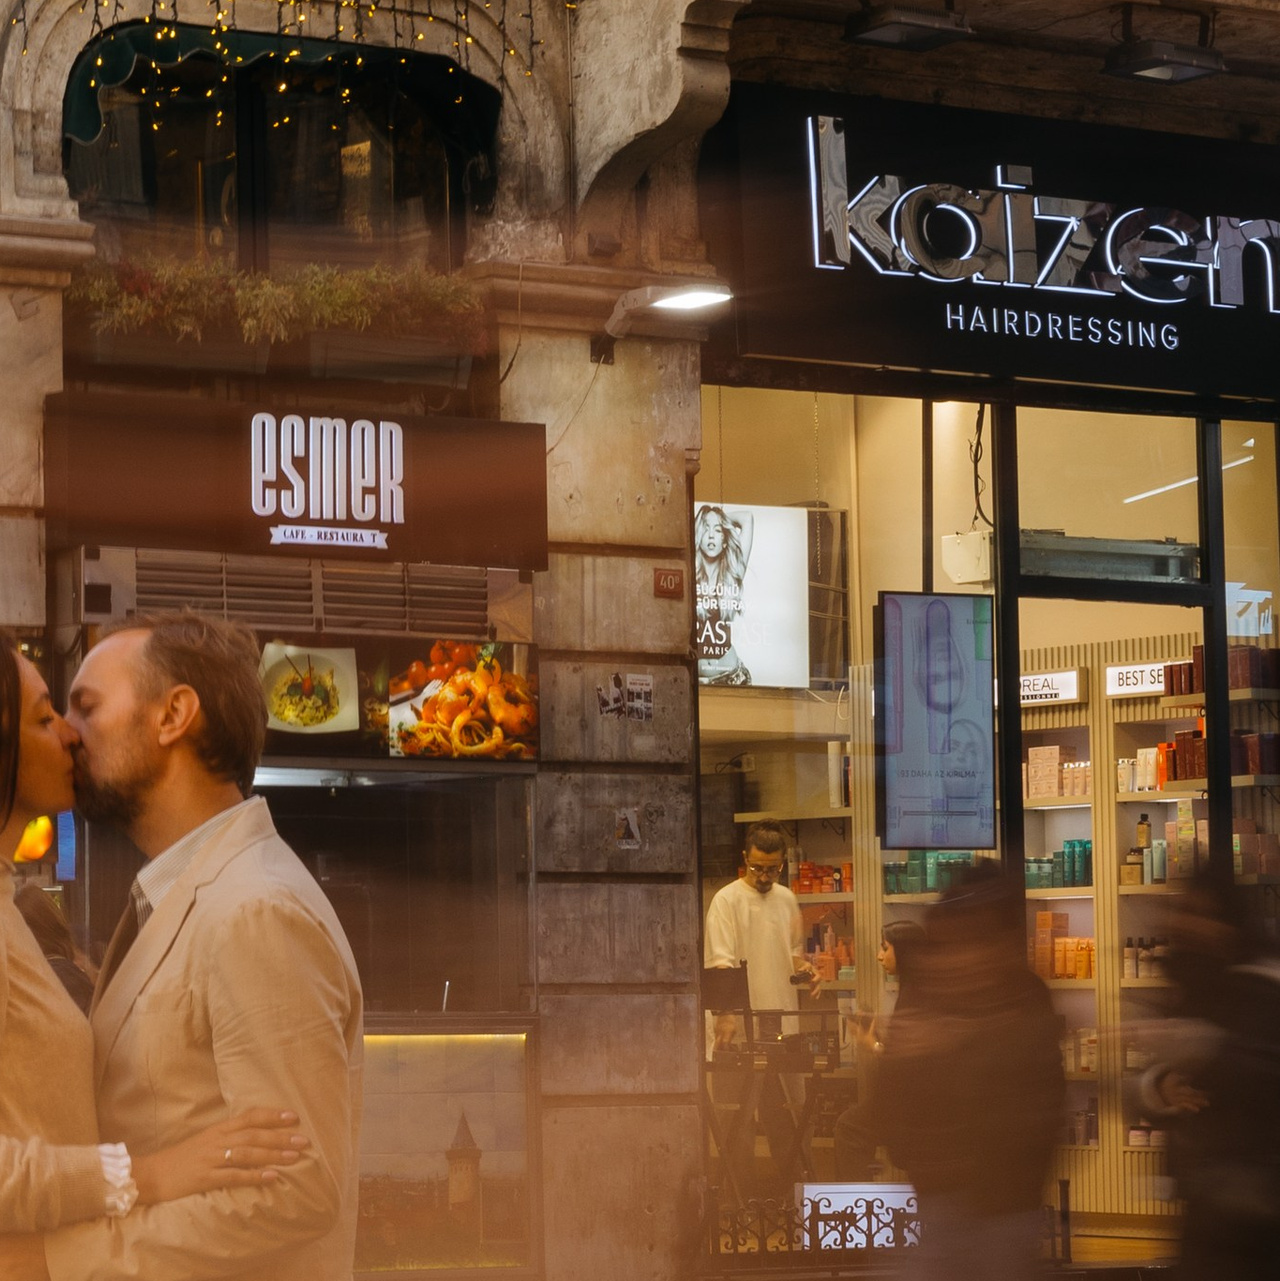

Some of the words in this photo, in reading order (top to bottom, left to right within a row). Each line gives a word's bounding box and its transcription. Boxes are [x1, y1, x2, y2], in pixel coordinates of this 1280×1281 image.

[807, 114, 1280, 314] kaizen
[945, 302, 1181, 350] HAIRDRESSING
[283, 528, 306, 540] CAFE
[317, 531, 377, 543] RESTAURAT
[703, 646, 729, 655] PARIS
[1020, 677, 1060, 692] REAL
[1118, 670, 1145, 687] BEST
